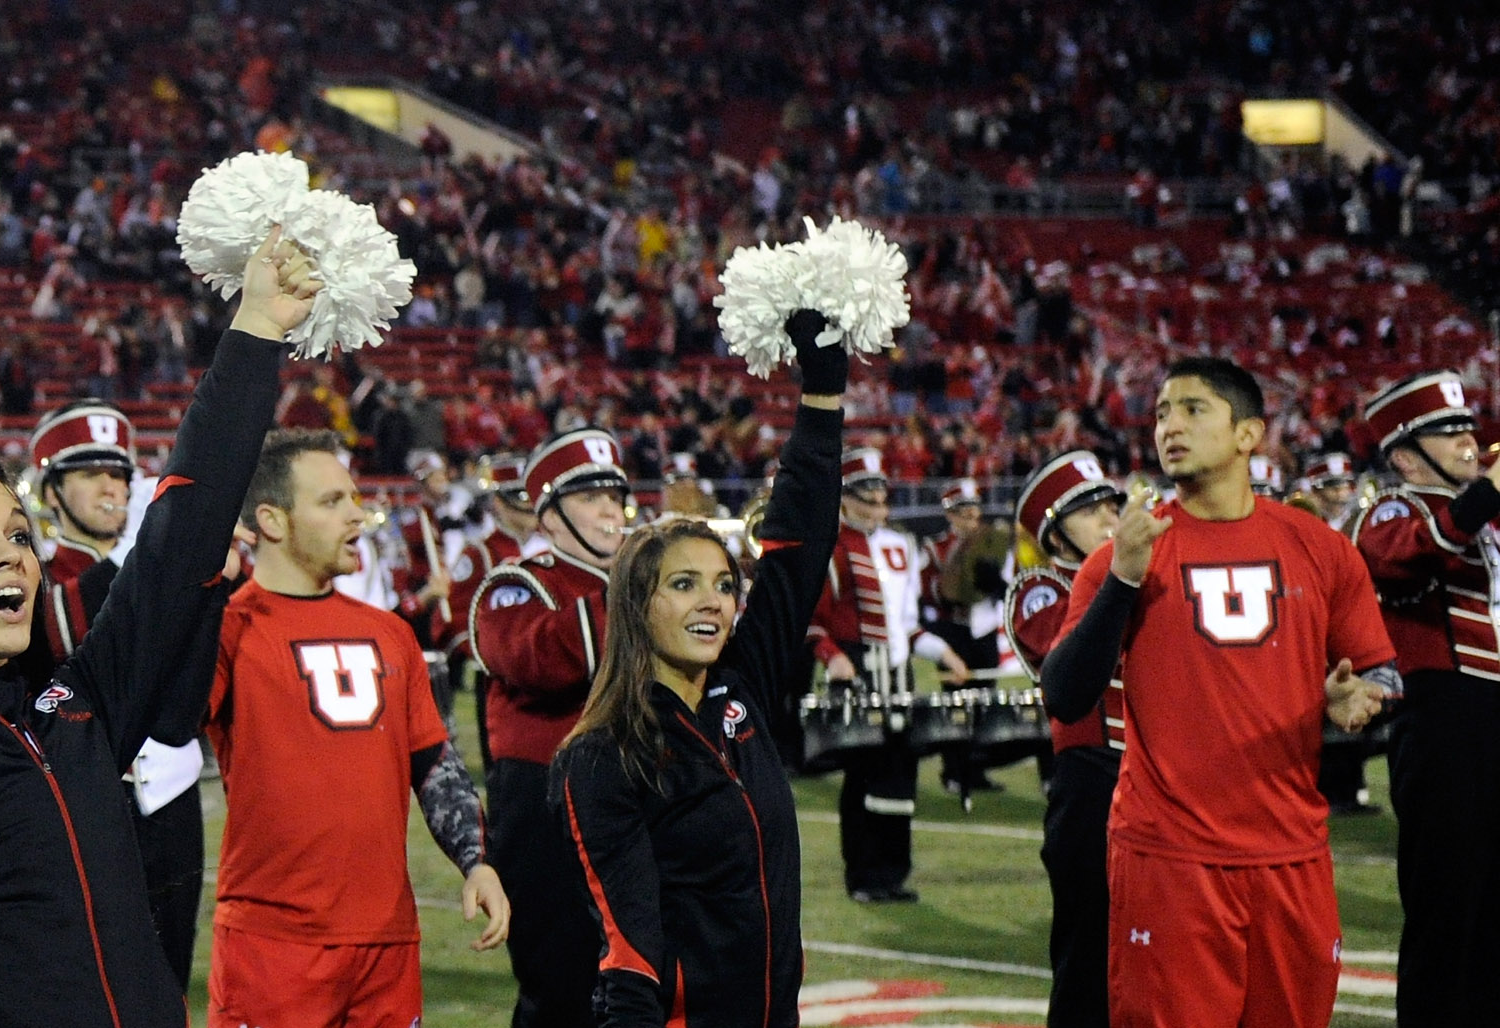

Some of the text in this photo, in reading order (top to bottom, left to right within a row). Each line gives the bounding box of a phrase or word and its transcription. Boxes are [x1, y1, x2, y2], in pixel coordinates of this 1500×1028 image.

[583, 438, 613, 465] U
[1073, 458, 1104, 481] U
[882, 547, 908, 571] U
[1183, 561, 1281, 646] U
[292, 640, 385, 730] U
